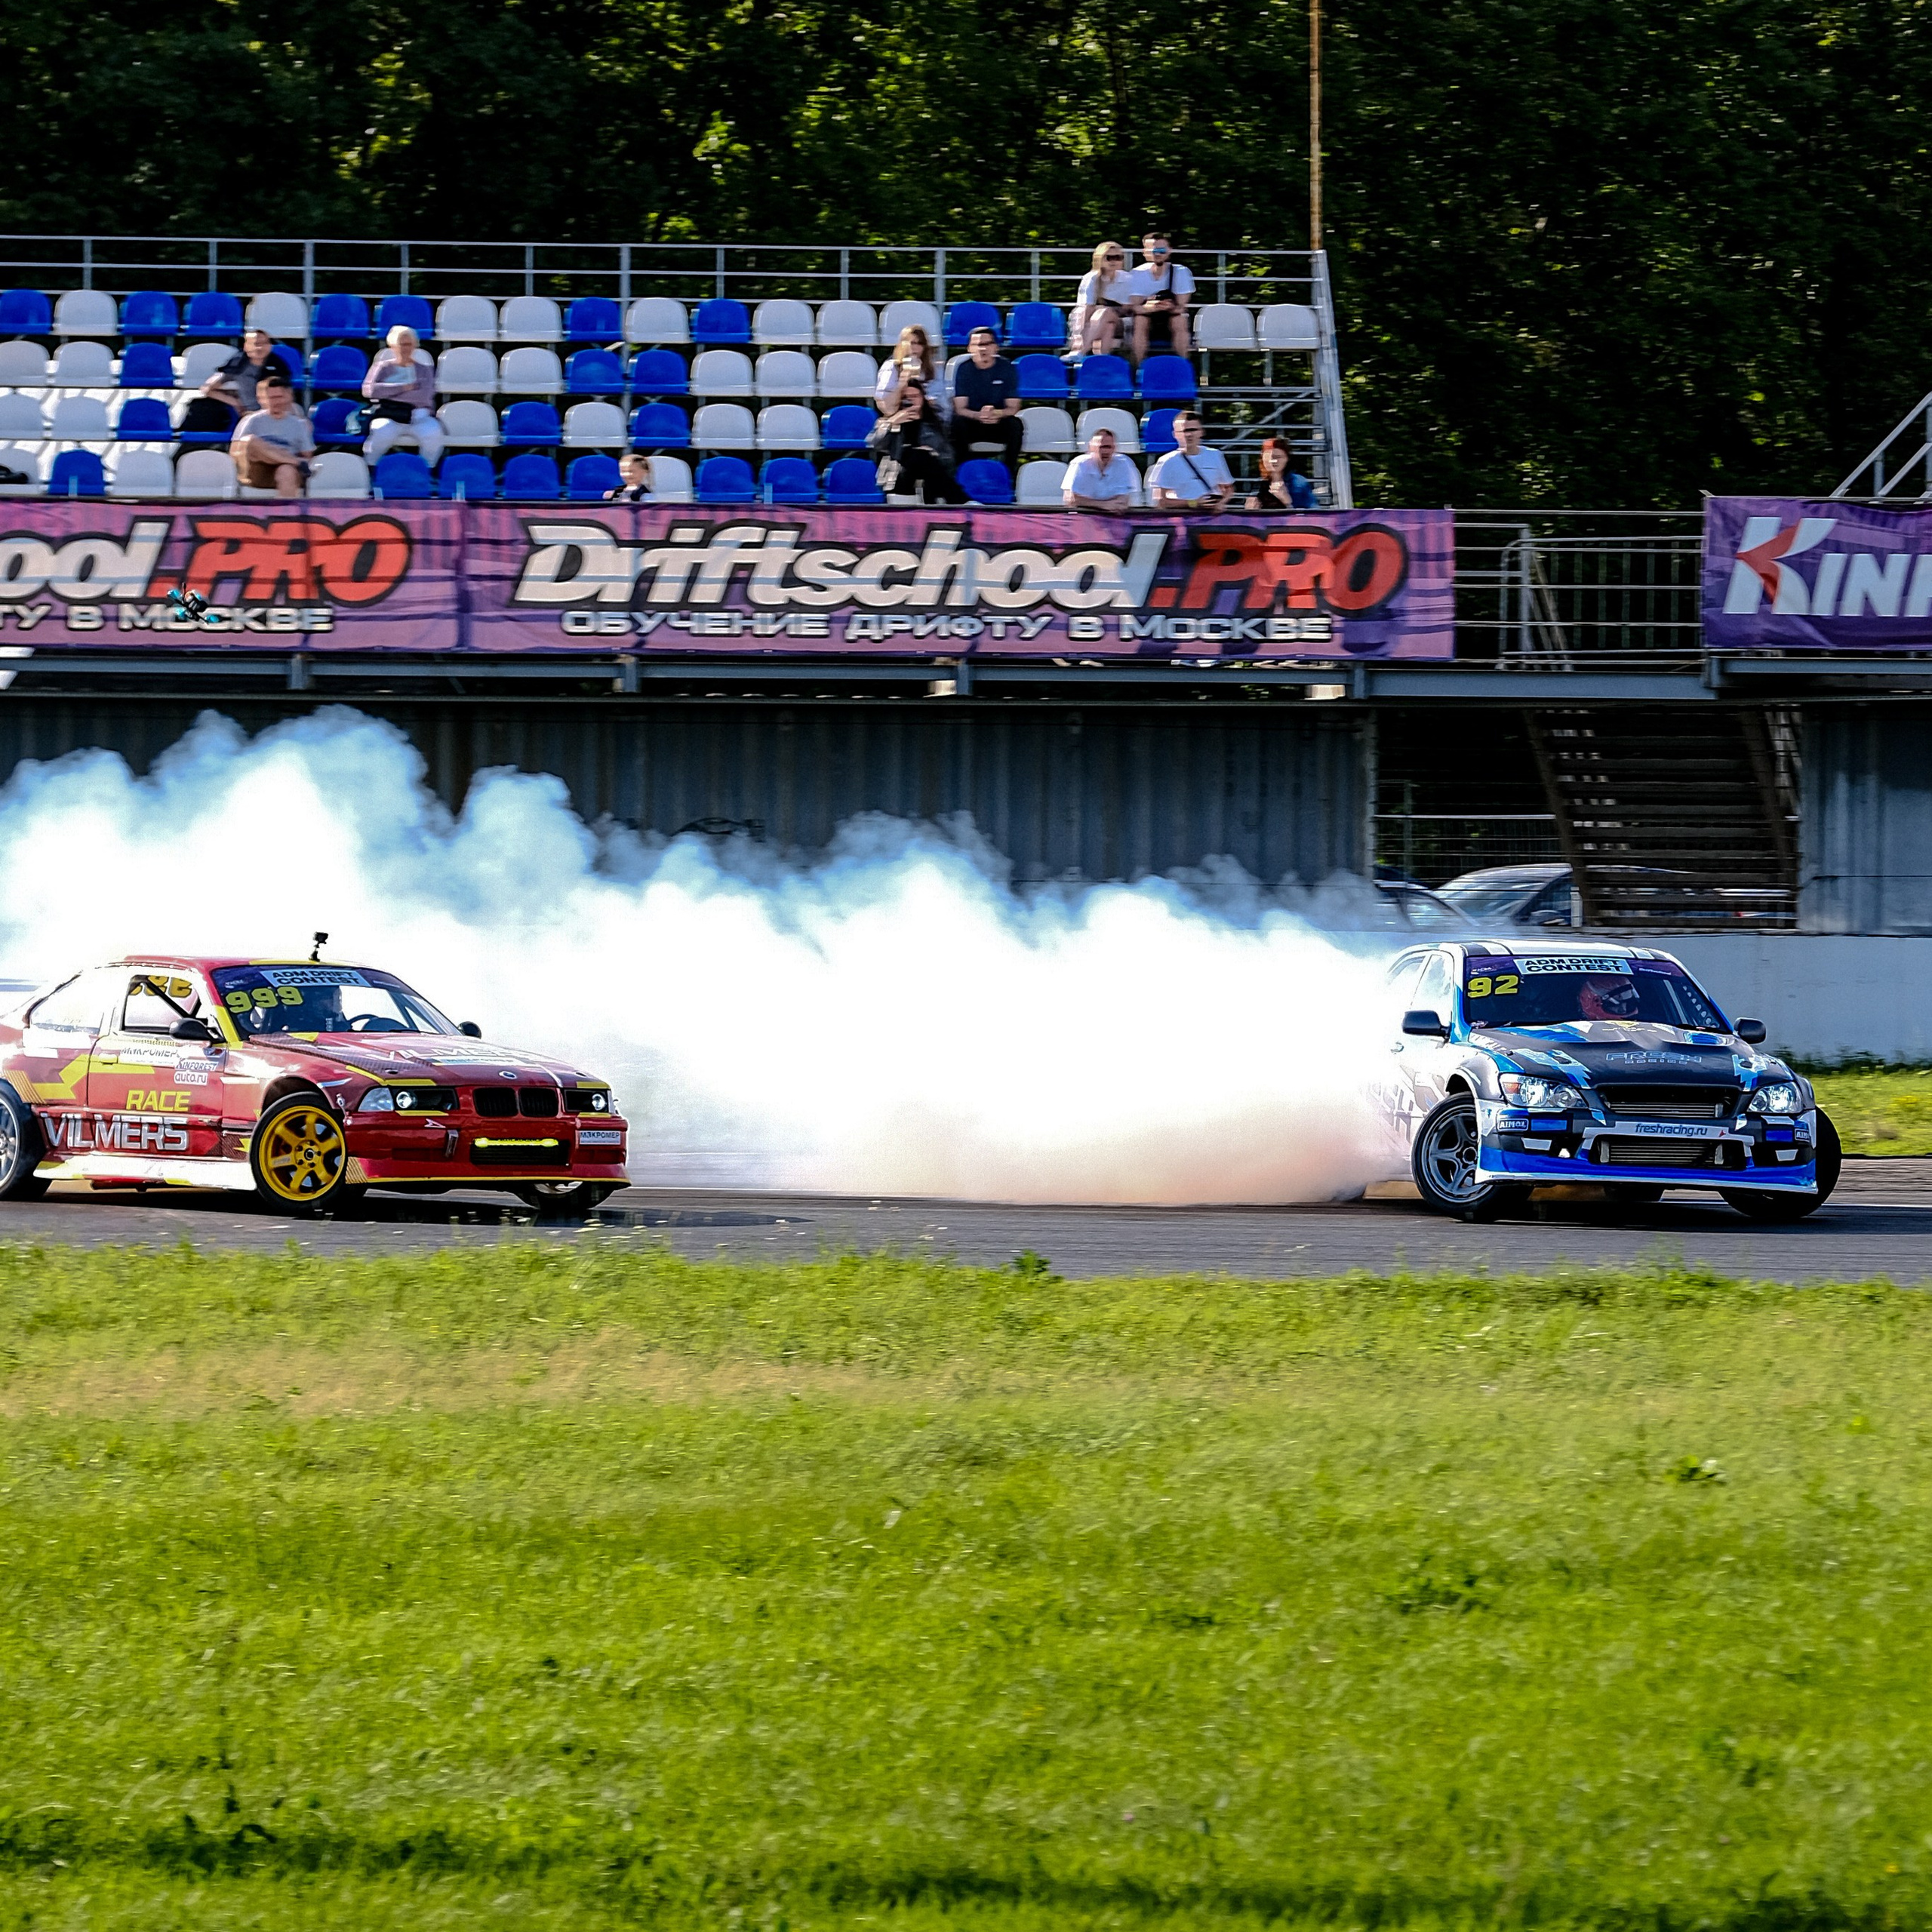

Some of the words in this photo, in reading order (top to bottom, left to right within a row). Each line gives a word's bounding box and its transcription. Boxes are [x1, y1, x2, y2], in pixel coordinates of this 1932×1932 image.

[514, 525, 1403, 610] Driftschool.PRO
[67, 605, 104, 629] В
[562, 611, 830, 635] ОБУЧЕНИЕ
[845, 614, 1054, 640] ДРИФТУ
[1069, 617, 1104, 638] В
[1119, 615, 1332, 639] МОСКВЕ
[1526, 964, 1623, 973] CONTEST
[1467, 975, 1519, 998] 92
[225, 986, 303, 1014] 999
[175, 1072, 207, 1084] auto.ru
[125, 1090, 192, 1112] RACE
[39, 1112, 189, 1151] VILMERS
[1635, 1123, 1708, 1137] freshracing.ru
